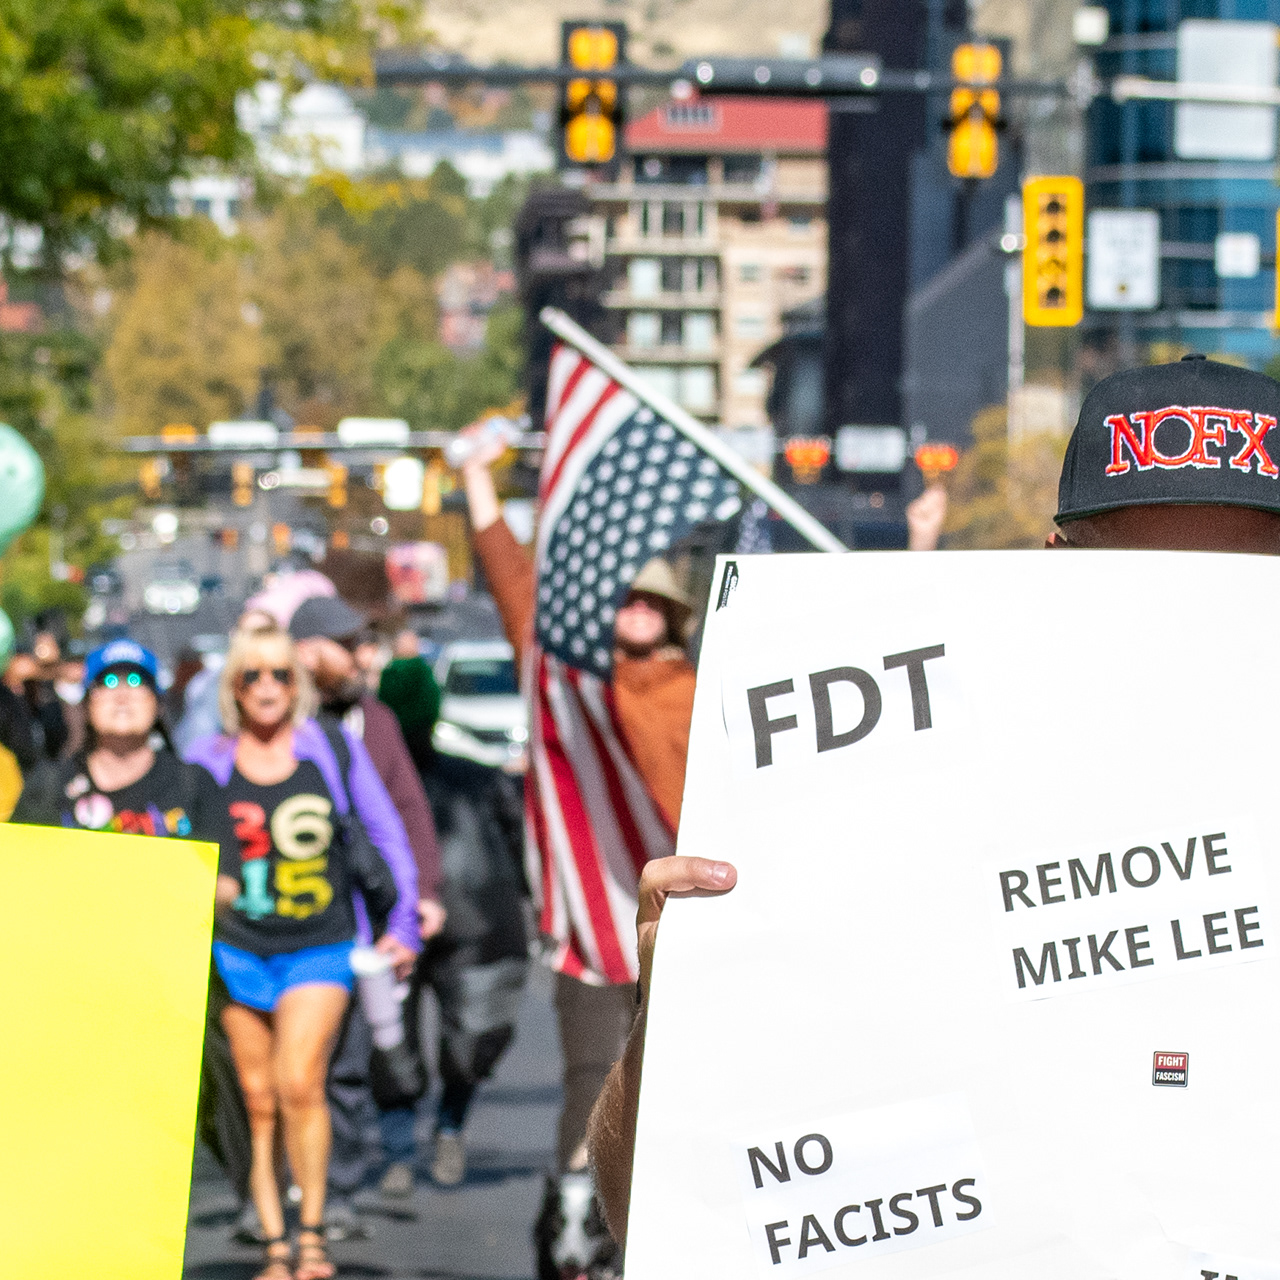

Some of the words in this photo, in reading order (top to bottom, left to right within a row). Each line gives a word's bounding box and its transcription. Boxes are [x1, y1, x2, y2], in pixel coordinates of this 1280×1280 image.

[1104, 405, 1279, 479] NOFX
[746, 643, 945, 769] FDT
[999, 832, 1232, 913] REMOVE
[1012, 924, 1155, 989] MIKE
[1170, 905, 1264, 961] LEE
[1155, 1071, 1185, 1082] FASCISM
[1158, 1055, 1185, 1067] FIGHT
[747, 1133, 834, 1189] NO
[764, 1178, 982, 1265] FACISTS
